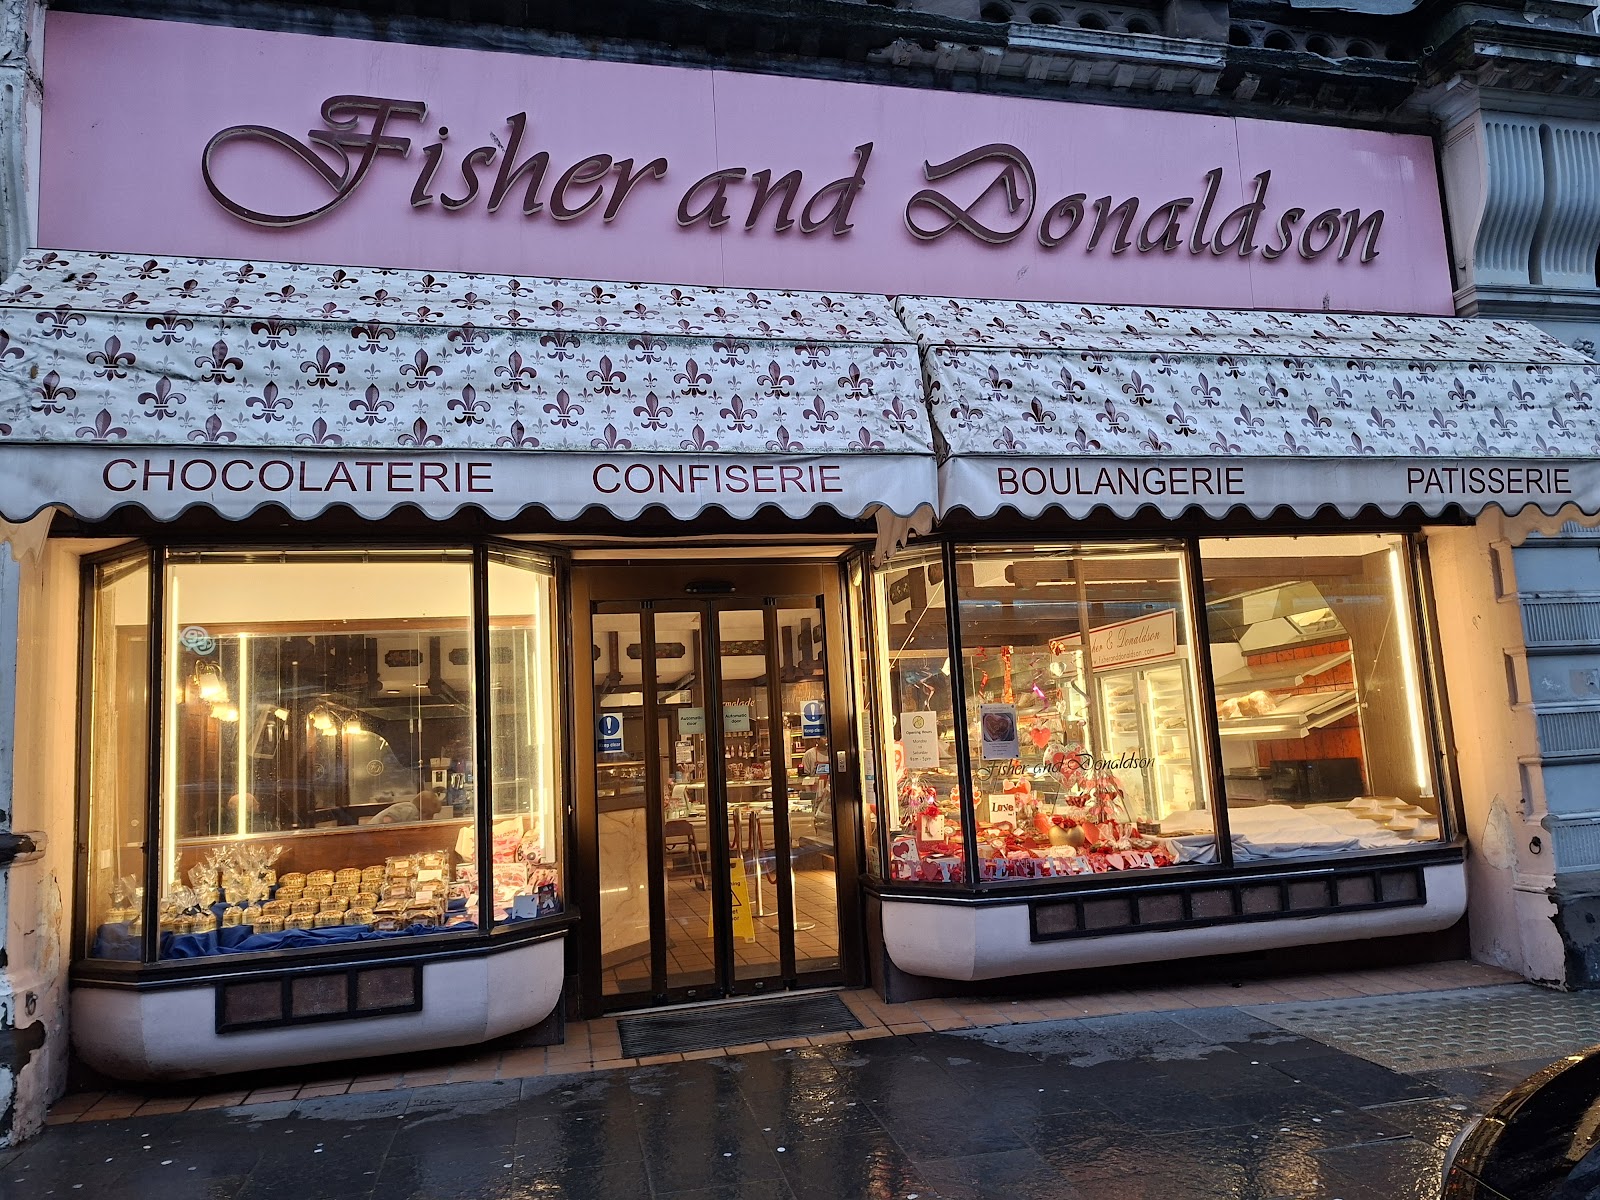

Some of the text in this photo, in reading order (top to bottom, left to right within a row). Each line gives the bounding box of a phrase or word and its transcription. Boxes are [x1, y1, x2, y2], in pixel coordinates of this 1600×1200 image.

[201, 94, 1386, 264] Fisher and Donaldson
[102, 458, 495, 494] CHOCOLATERIE
[592, 462, 843, 494] CONFISERIE
[998, 467, 1246, 497] BOULANGERIE
[1407, 467, 1572, 496] PATISSERIE
[1117, 625, 1161, 648] Donaldson
[1092, 647, 1155, 665] w.fisheranddonaldson.com
[977, 750, 1156, 782] Fisher and Donaldson
[991, 802, 1014, 812] Love
